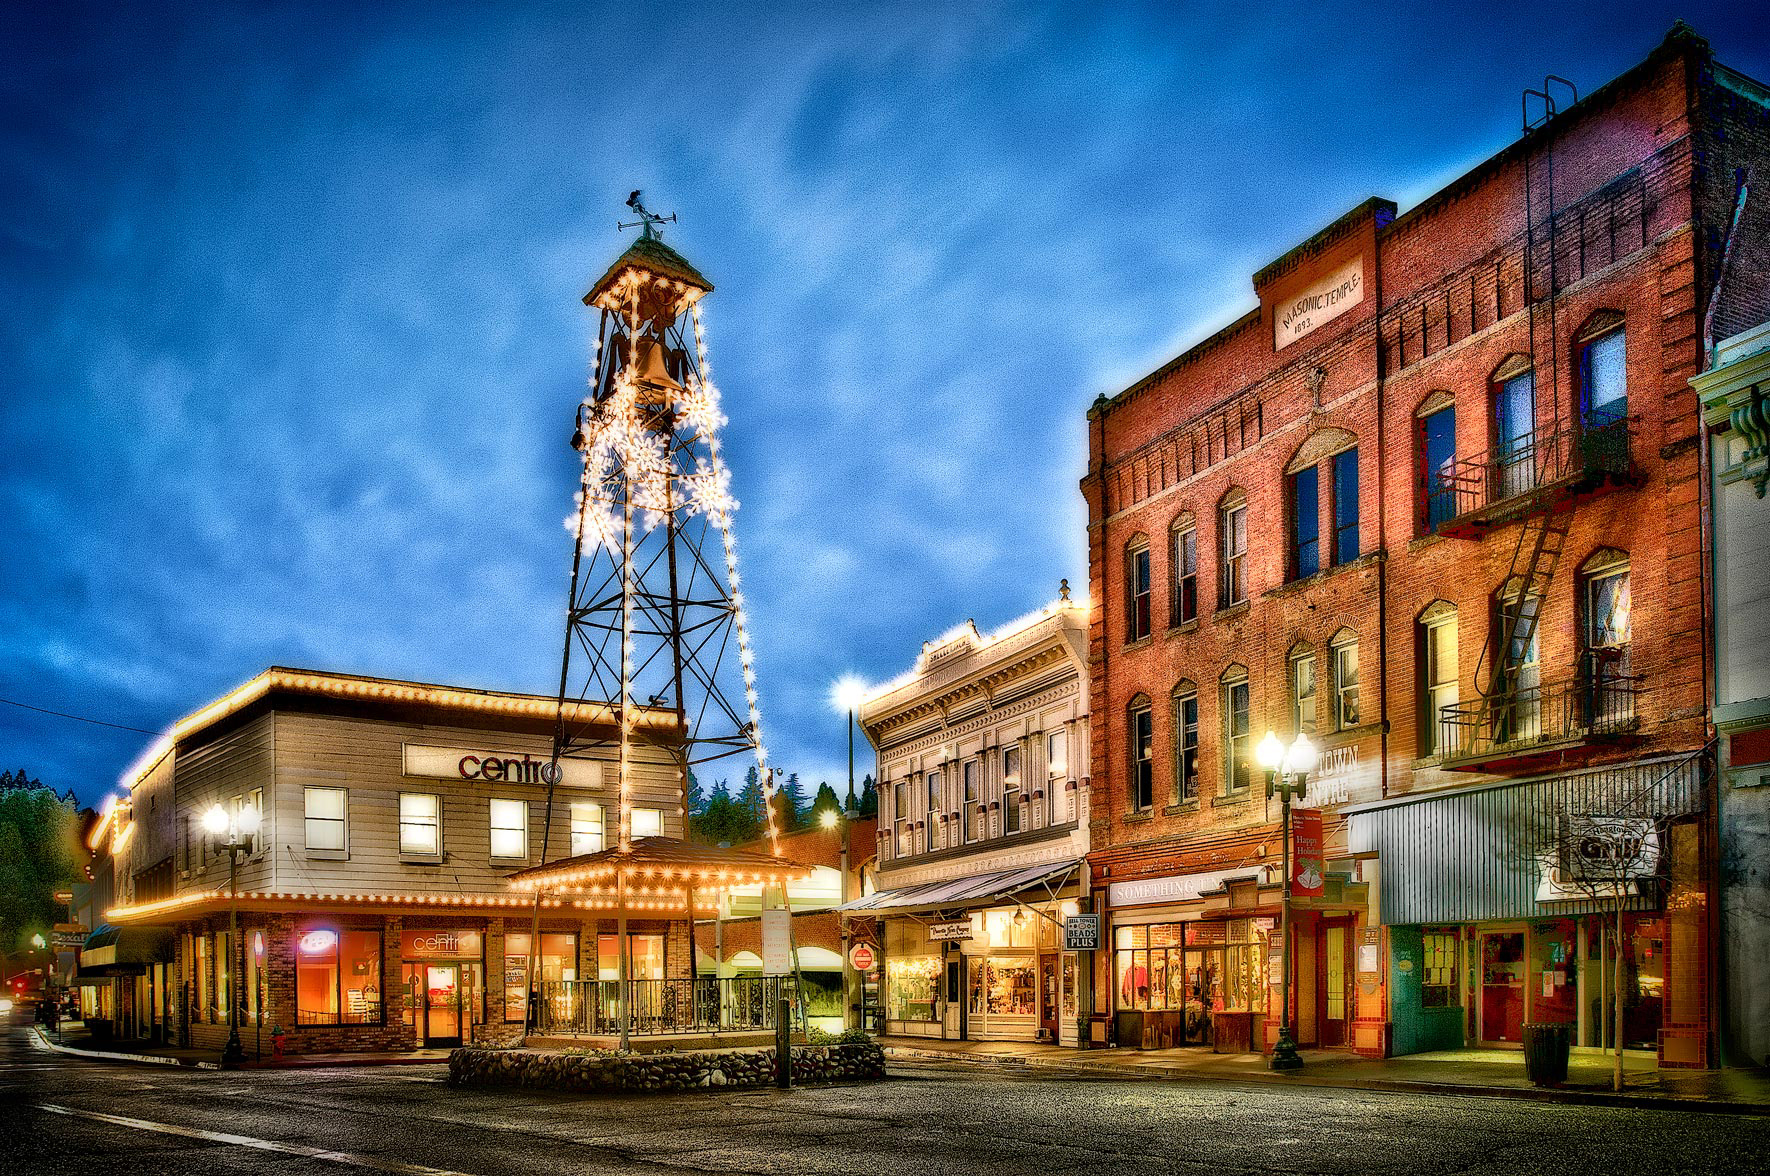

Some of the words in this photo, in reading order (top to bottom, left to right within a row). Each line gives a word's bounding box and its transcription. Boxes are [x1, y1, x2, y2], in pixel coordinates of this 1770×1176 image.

[458, 754, 563, 785] centro
[1317, 744, 1359, 777] TOWN
[1296, 778, 1349, 809] ENTRE
[1296, 835, 1317, 847] Happy
[1117, 880, 1194, 900] SOMETHING
[1199, 877, 1221, 890] UN
[1068, 929, 1096, 937] BEADS
[1071, 938, 1094, 947] PLUS
